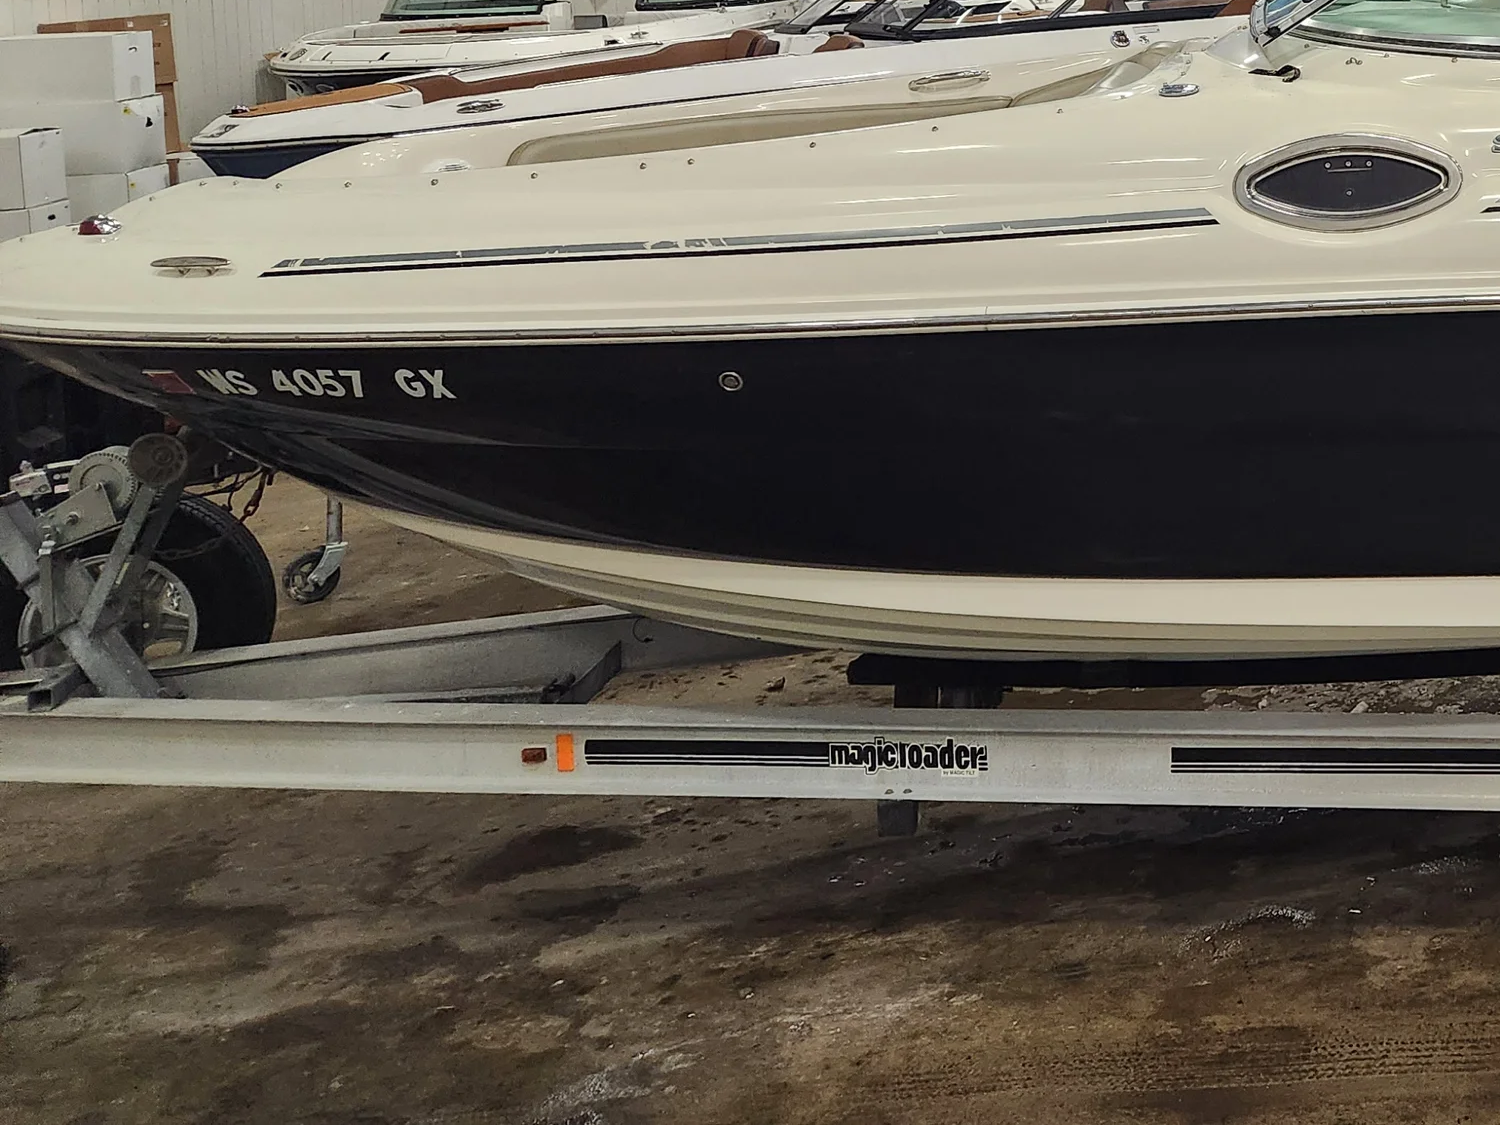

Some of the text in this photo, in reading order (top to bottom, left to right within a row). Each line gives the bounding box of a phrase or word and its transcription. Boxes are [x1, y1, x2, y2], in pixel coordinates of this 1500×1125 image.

[196, 368, 457, 399] WS 4057 GX
